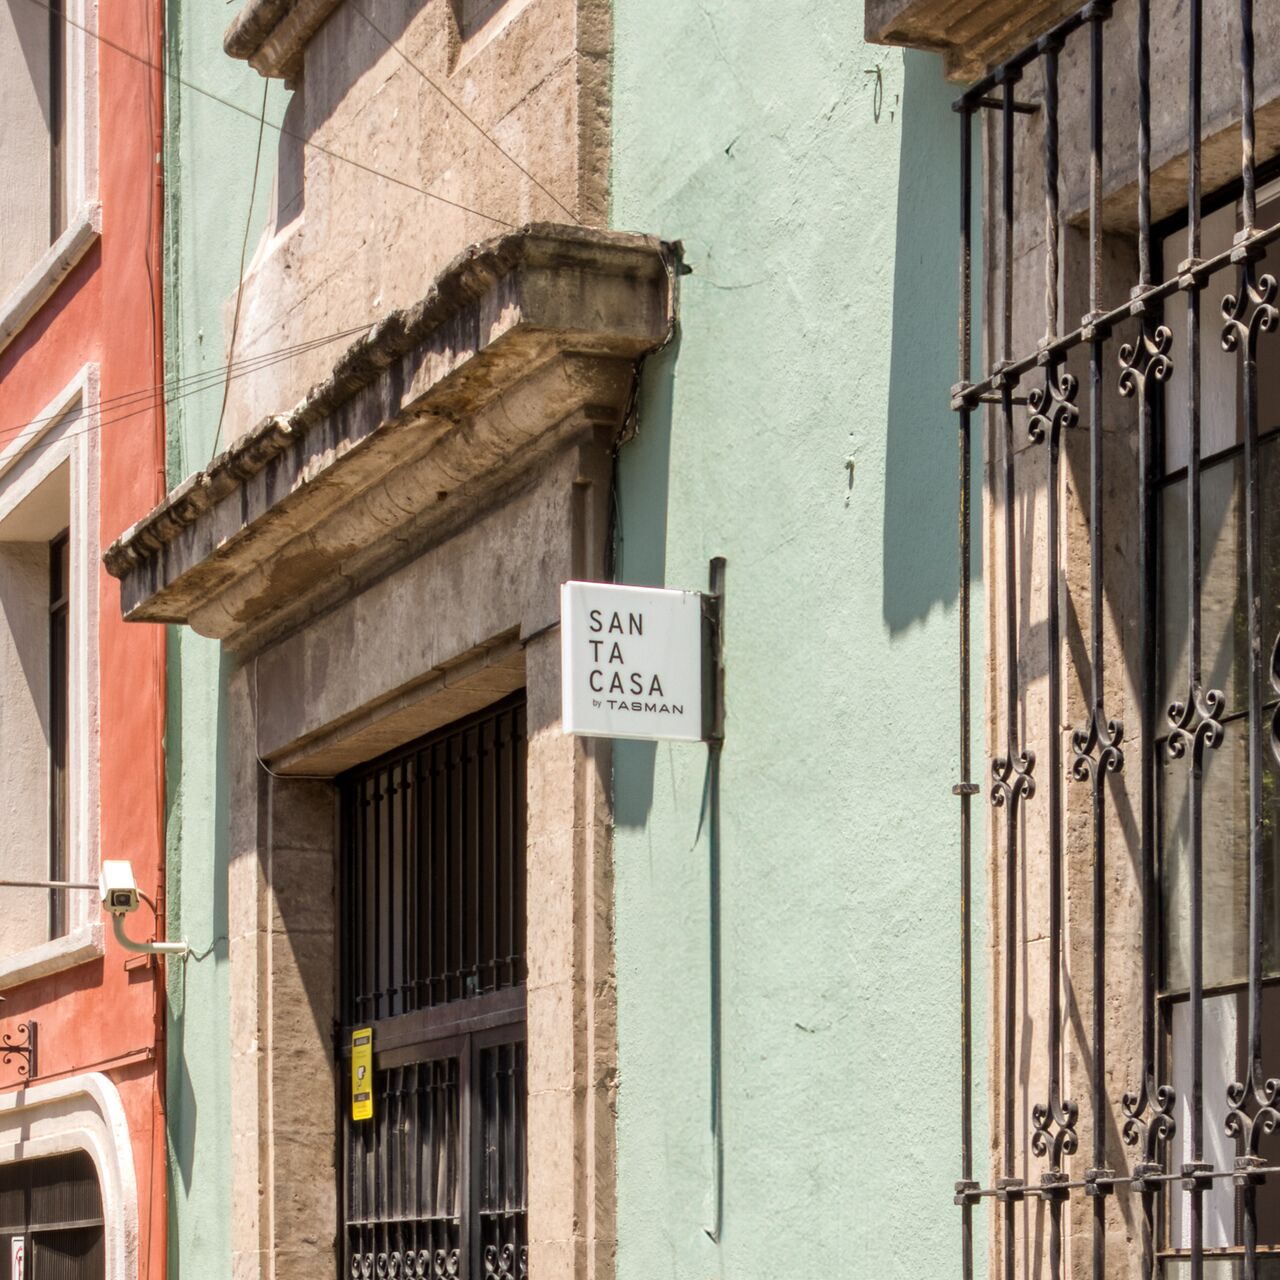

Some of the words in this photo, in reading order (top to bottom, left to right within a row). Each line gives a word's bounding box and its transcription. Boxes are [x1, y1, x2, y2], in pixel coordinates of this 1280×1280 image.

[589, 610, 643, 636] SAN
[589, 639, 624, 665] TA
[589, 669, 664, 697] CASA
[592, 699, 602, 709] by
[607, 700, 684, 715] TASMAN
